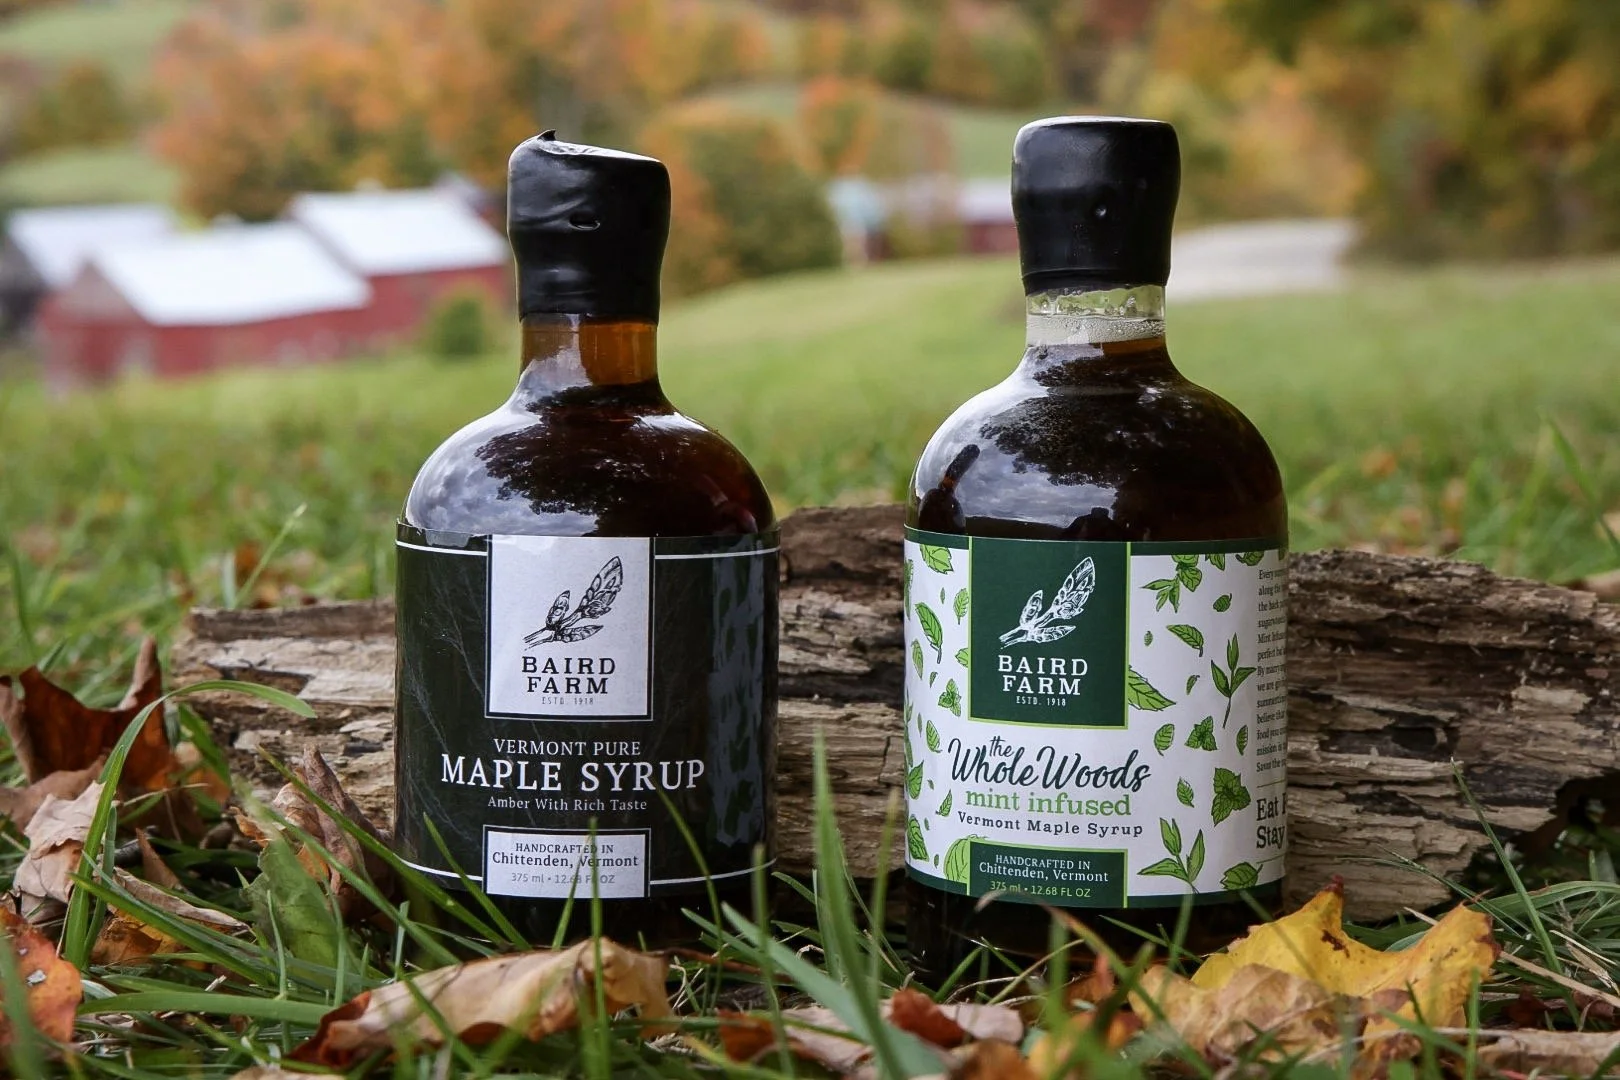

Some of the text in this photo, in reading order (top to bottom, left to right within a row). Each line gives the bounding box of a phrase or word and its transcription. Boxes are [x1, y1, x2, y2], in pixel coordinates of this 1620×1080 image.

[521, 656, 616, 674] BAIRD
[997, 654, 1088, 676] BAIRD
[526, 676, 609, 694] FARM
[1002, 675, 1081, 695] FARM
[574, 697, 594, 705] 1918
[1016, 695, 1066, 706] ESTD. 1918
[493, 738, 641, 756] VERMONT PURE
[989, 735, 1014, 758] the
[441, 753, 706, 792] MAPLE SYRUP
[948, 738, 1152, 793] Whole Woods
[487, 796, 648, 812] Amber With Rich Taste
[965, 788, 1132, 816] mint infused
[1256, 796, 1278, 821] Eat
[957, 810, 1144, 838] Vermont Maple Syrup
[1256, 825, 1285, 850] Stay
[515, 843, 614, 854] HANDCRAFTED IN
[492, 852, 639, 869] Chittenden, Vermont
[995, 854, 1091, 870] HANDCRAFTED IN
[511, 873, 528, 882] 375
[532, 874, 544, 883] ml
[600, 874, 616, 884] OZ
[979, 861, 1109, 882] Chittenden, Vermont
[990, 880, 1092, 898] 375 ml 12.68 FL OZ
